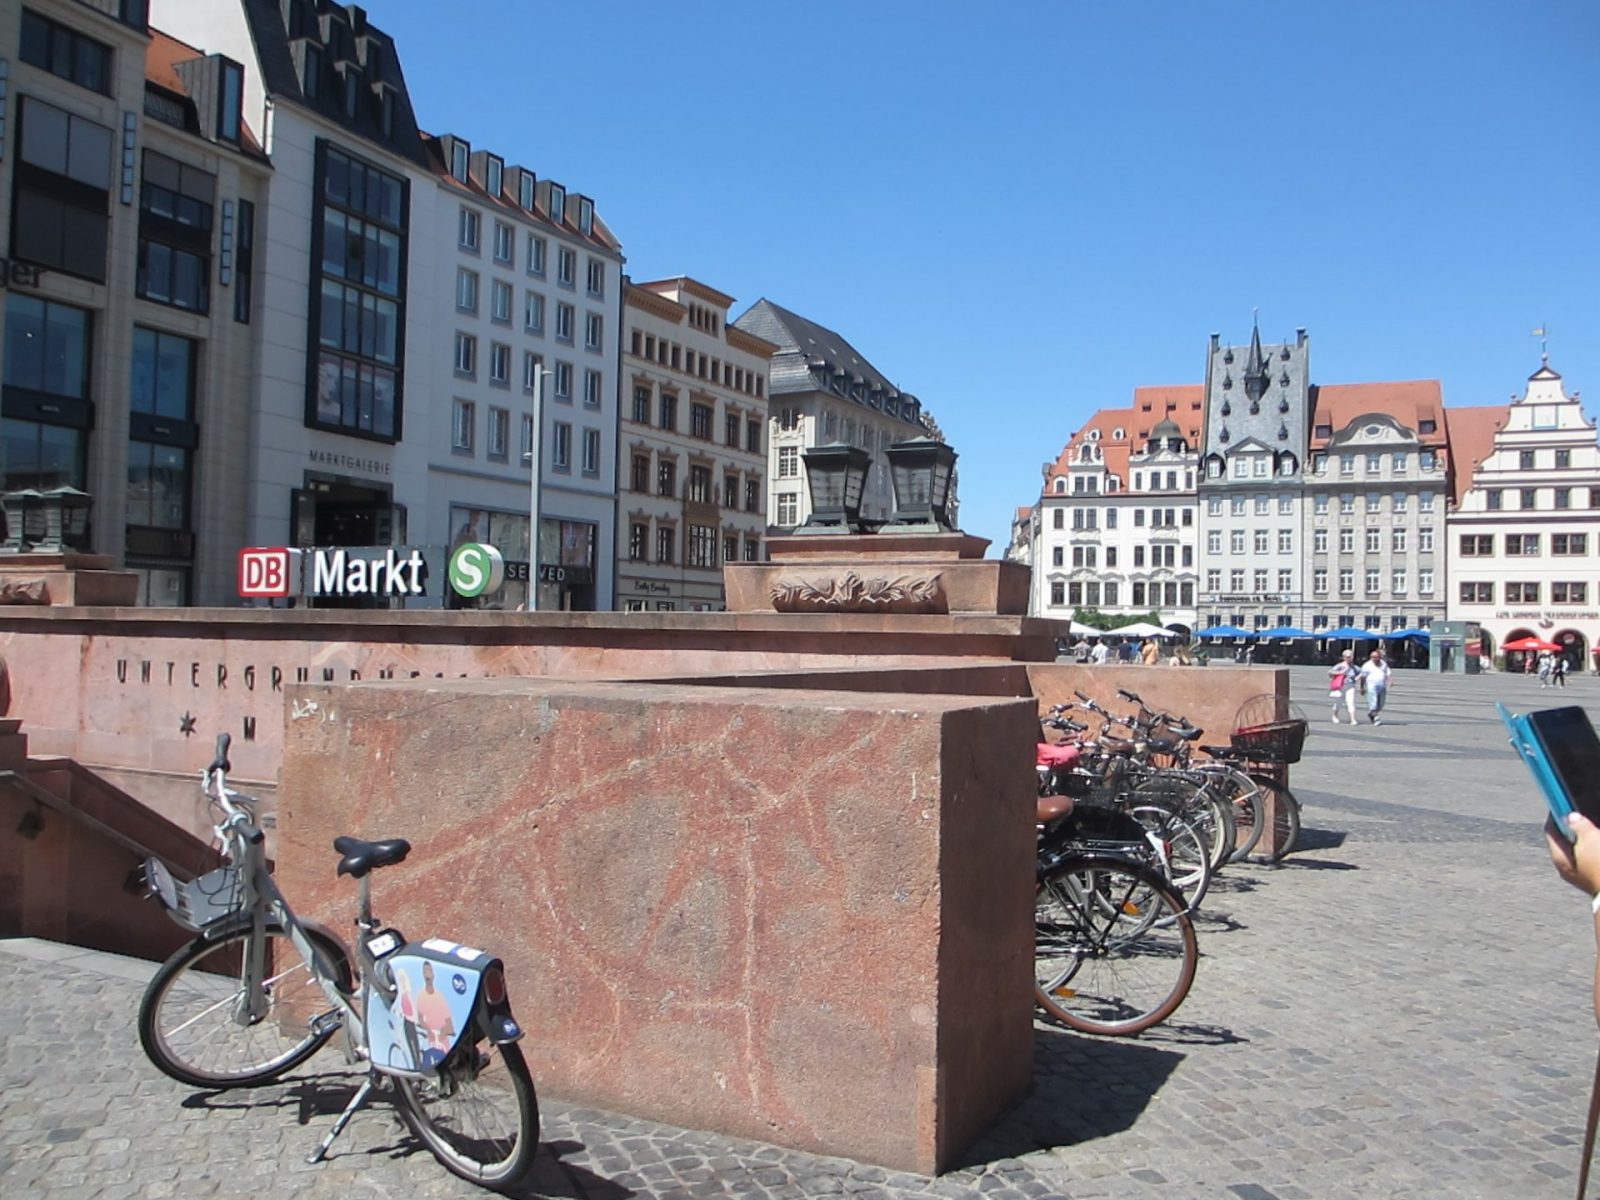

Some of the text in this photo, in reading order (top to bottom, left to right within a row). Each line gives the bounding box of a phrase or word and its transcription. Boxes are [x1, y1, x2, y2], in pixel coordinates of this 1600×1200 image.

[309, 450, 390, 475] MARKTGALERIE
[246, 556, 282, 588] DB
[314, 549, 424, 593] Markt
[455, 549, 482, 591] S
[508, 564, 565, 582] SEVED
